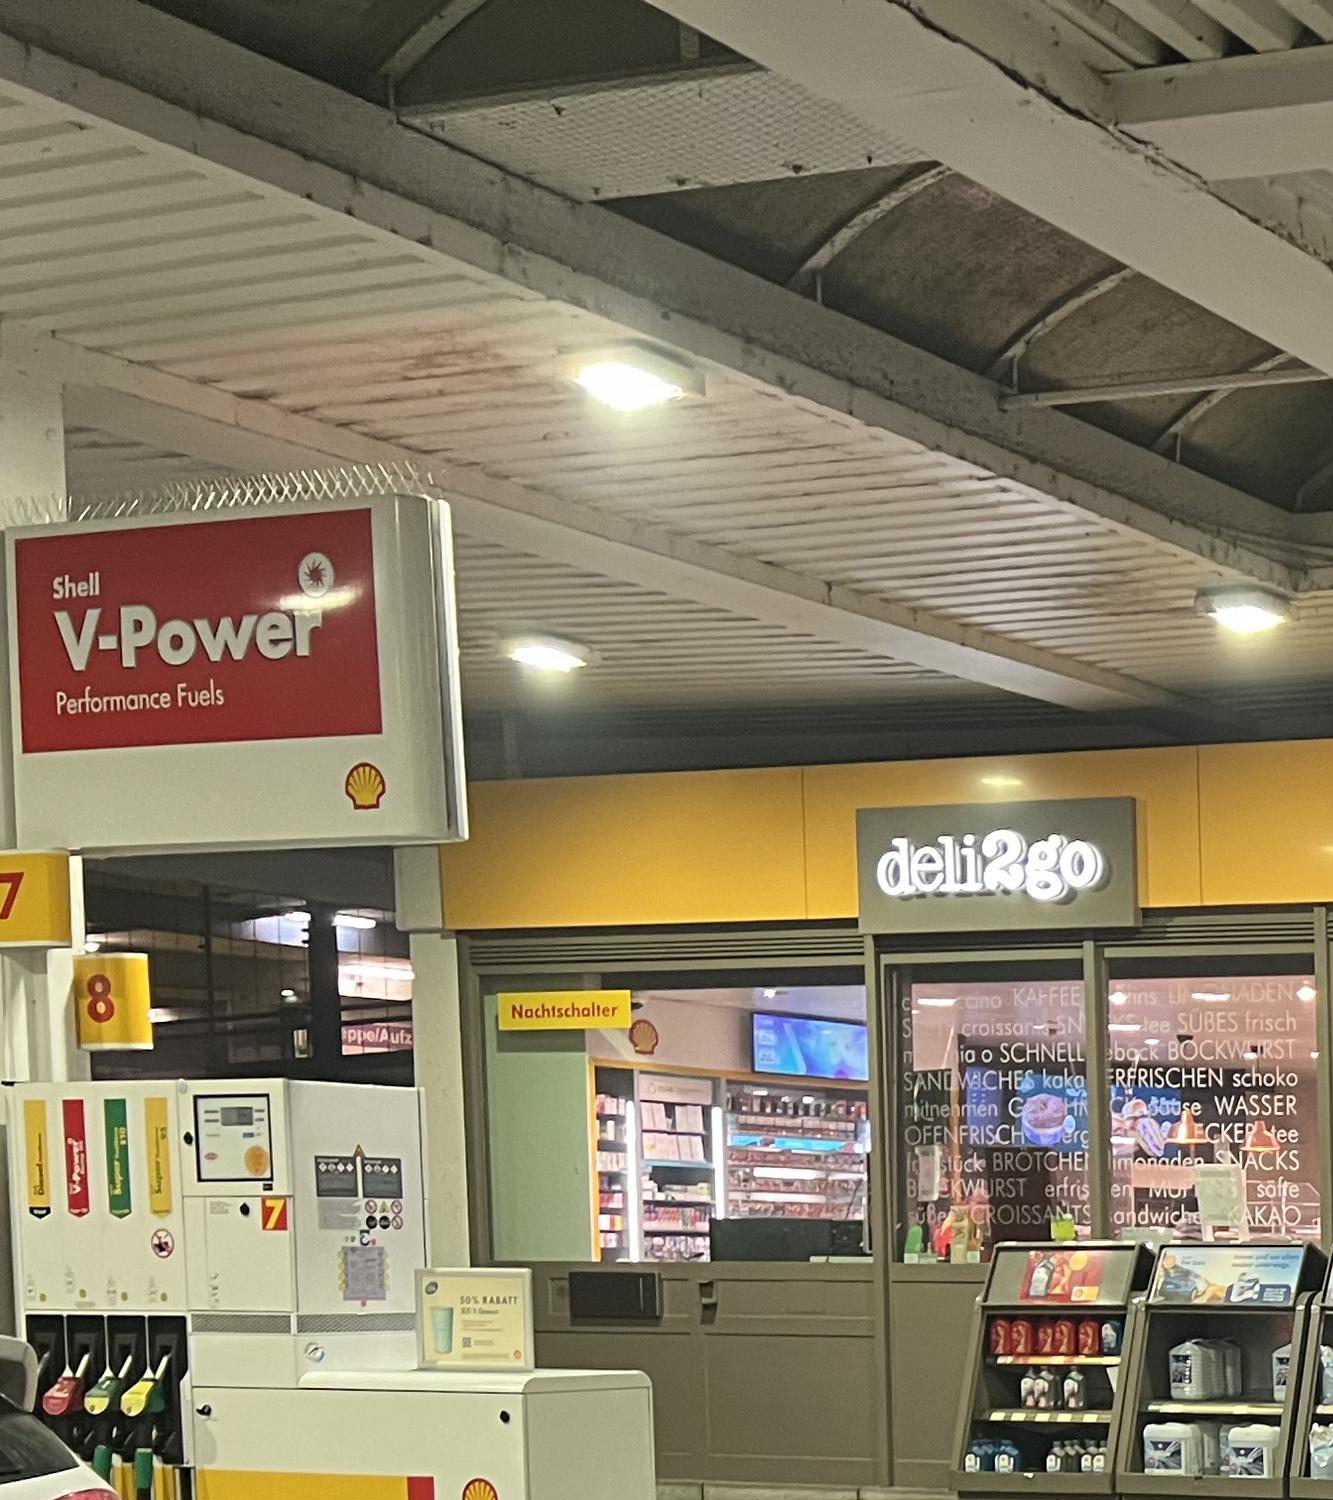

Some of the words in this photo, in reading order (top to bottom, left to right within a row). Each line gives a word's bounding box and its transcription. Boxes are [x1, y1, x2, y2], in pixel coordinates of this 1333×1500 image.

[53, 572, 100, 599] Shell
[54, 605, 323, 672] V-Power
[57, 686, 172, 715] Performance
[177, 679, 225, 707] Fuels
[876, 828, 1104, 902] deli2go
[0, 872, 25, 920] 7
[86, 974, 115, 1023] 8
[511, 1002, 619, 1020] Nachtschalter
[1245, 1010, 1297, 1033] frisch
[1232, 1066, 1299, 1087] schoko
[1213, 1095, 1298, 1117] WASSER
[264, 1199, 285, 1230] 7
[482, 1295, 519, 1305] RABATT
